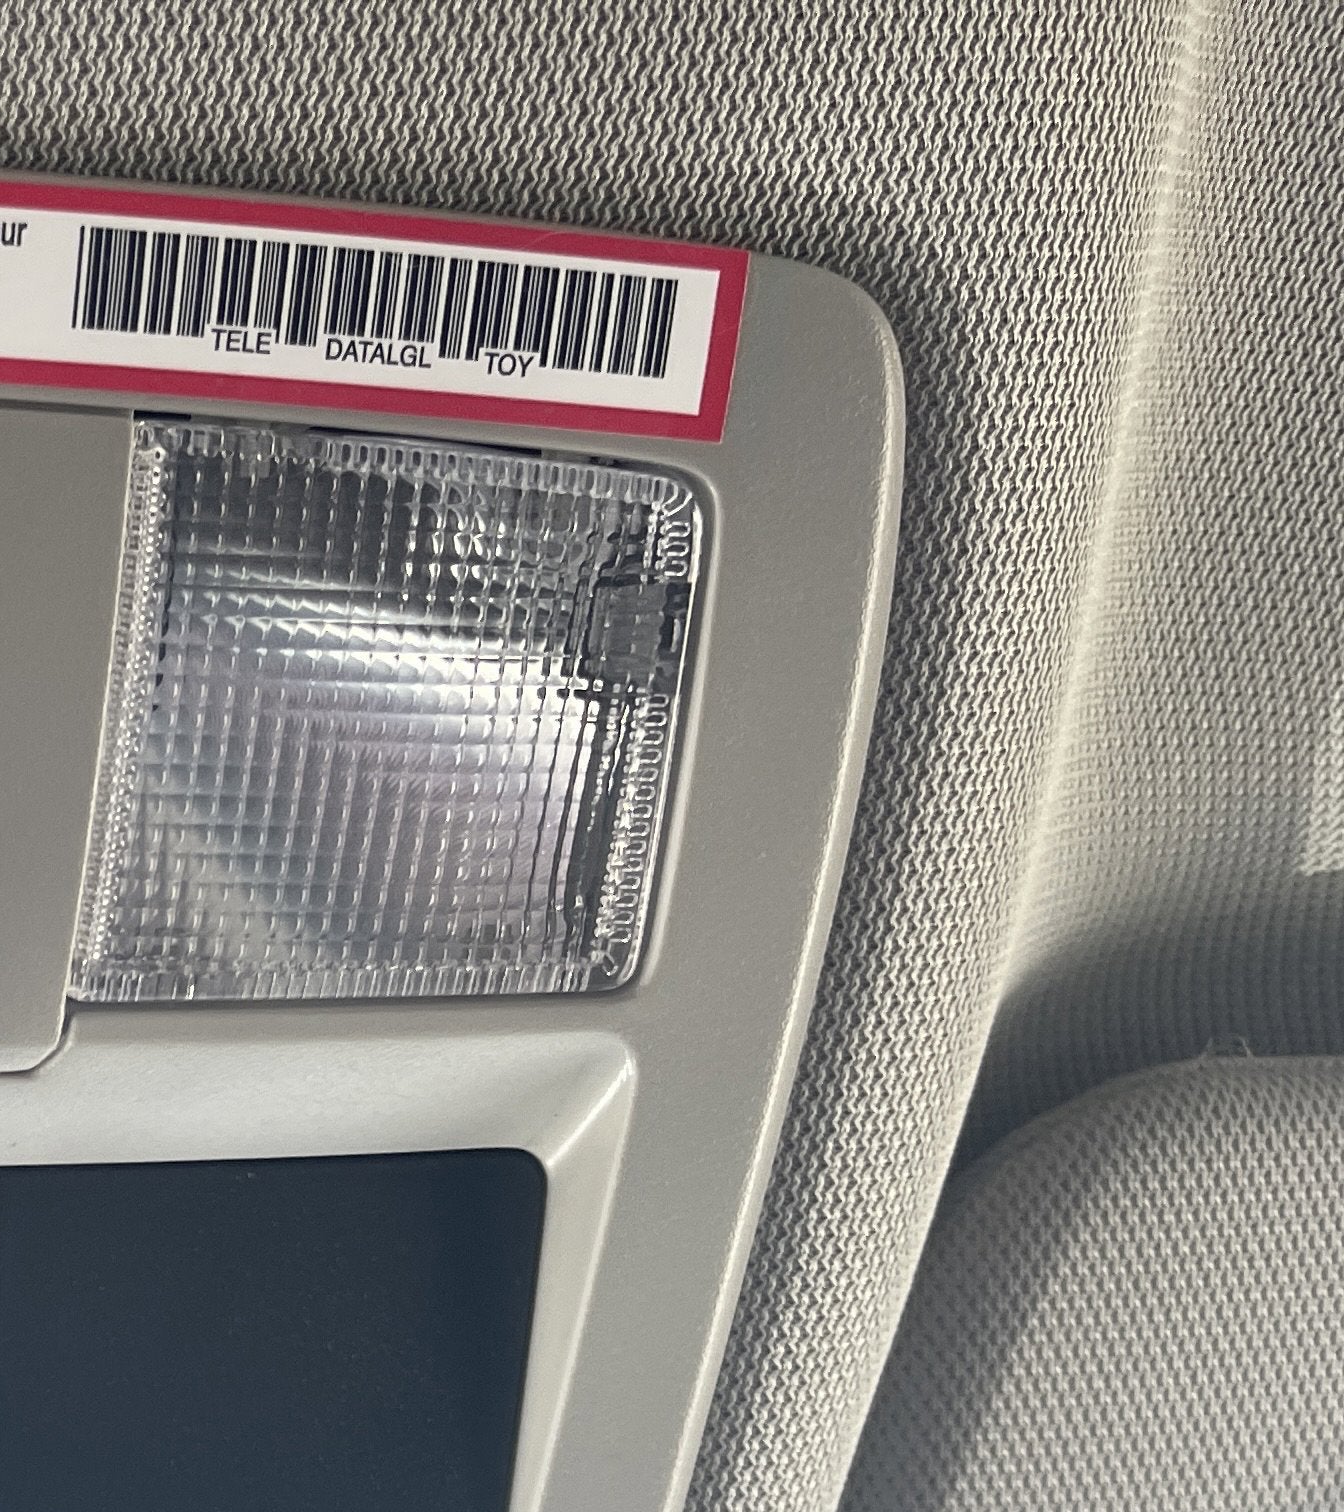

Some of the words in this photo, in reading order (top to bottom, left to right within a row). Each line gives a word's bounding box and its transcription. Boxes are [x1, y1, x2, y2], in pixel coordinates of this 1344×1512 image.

[213, 328, 272, 355] TELE
[325, 338, 431, 368] DATALGL
[485, 352, 535, 378] TOY
